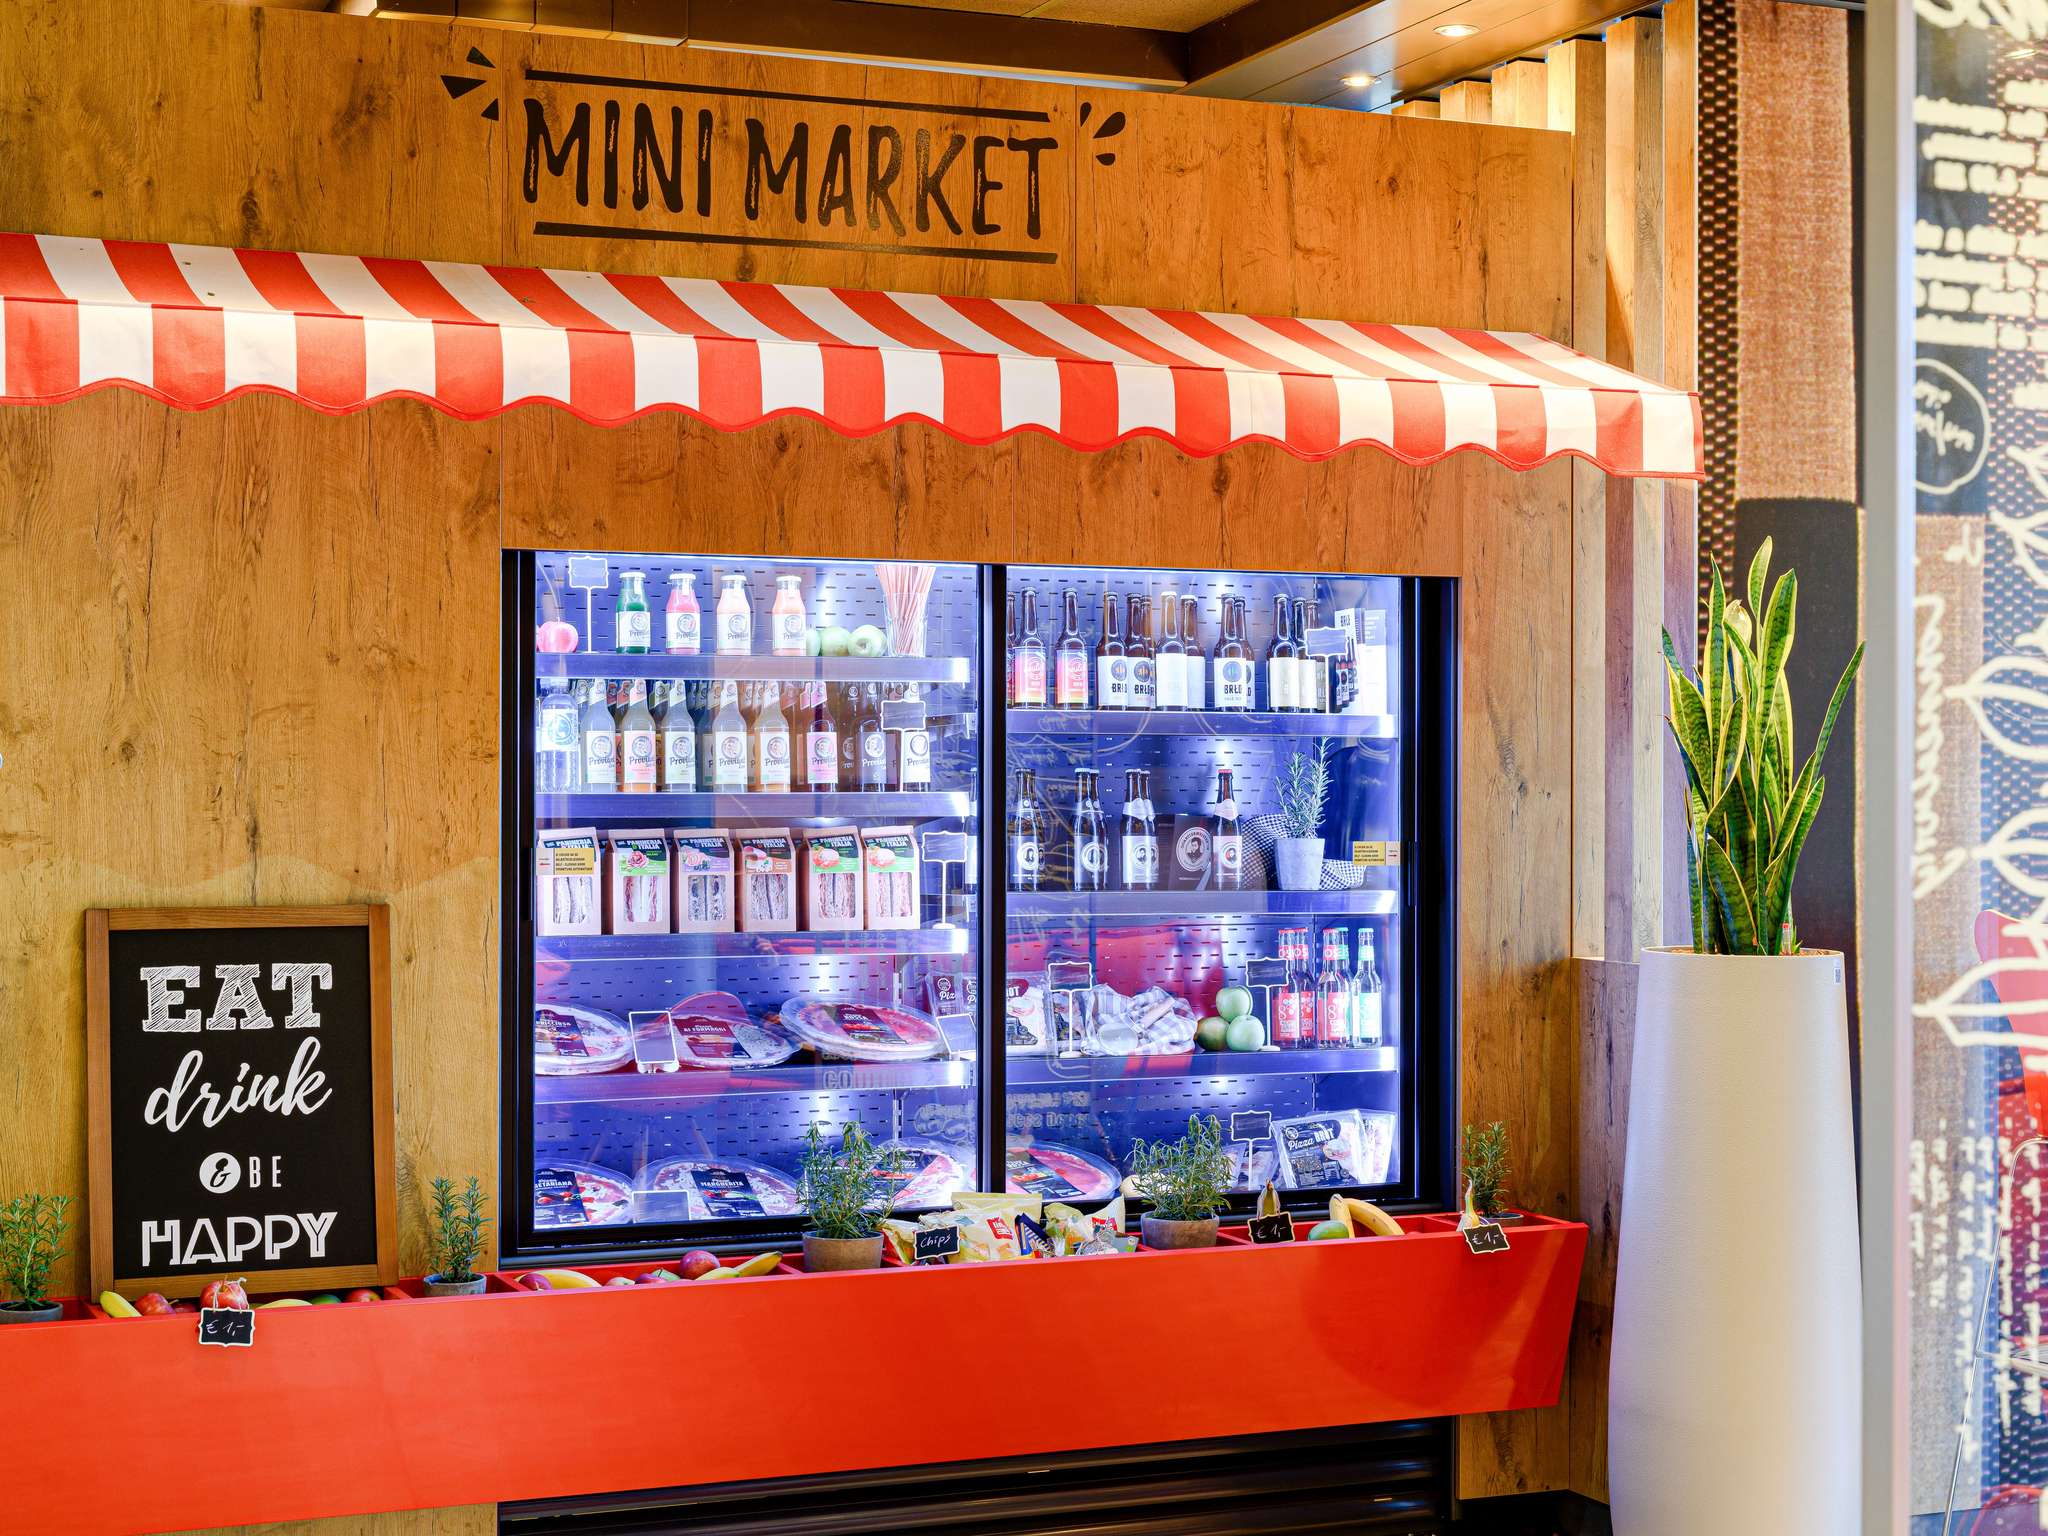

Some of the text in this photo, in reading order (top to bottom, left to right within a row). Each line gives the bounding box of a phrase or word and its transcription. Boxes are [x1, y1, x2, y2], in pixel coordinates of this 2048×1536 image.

[522, 97, 1059, 239] MINI MARKET
[139, 963, 333, 1032] EAT
[144, 1035, 333, 1132] drink
[249, 1155, 282, 1188] BE
[1287, 1138, 1315, 1151] Pizza
[141, 1211, 338, 1267] HAPPY
[206, 1319, 219, 1334] €
